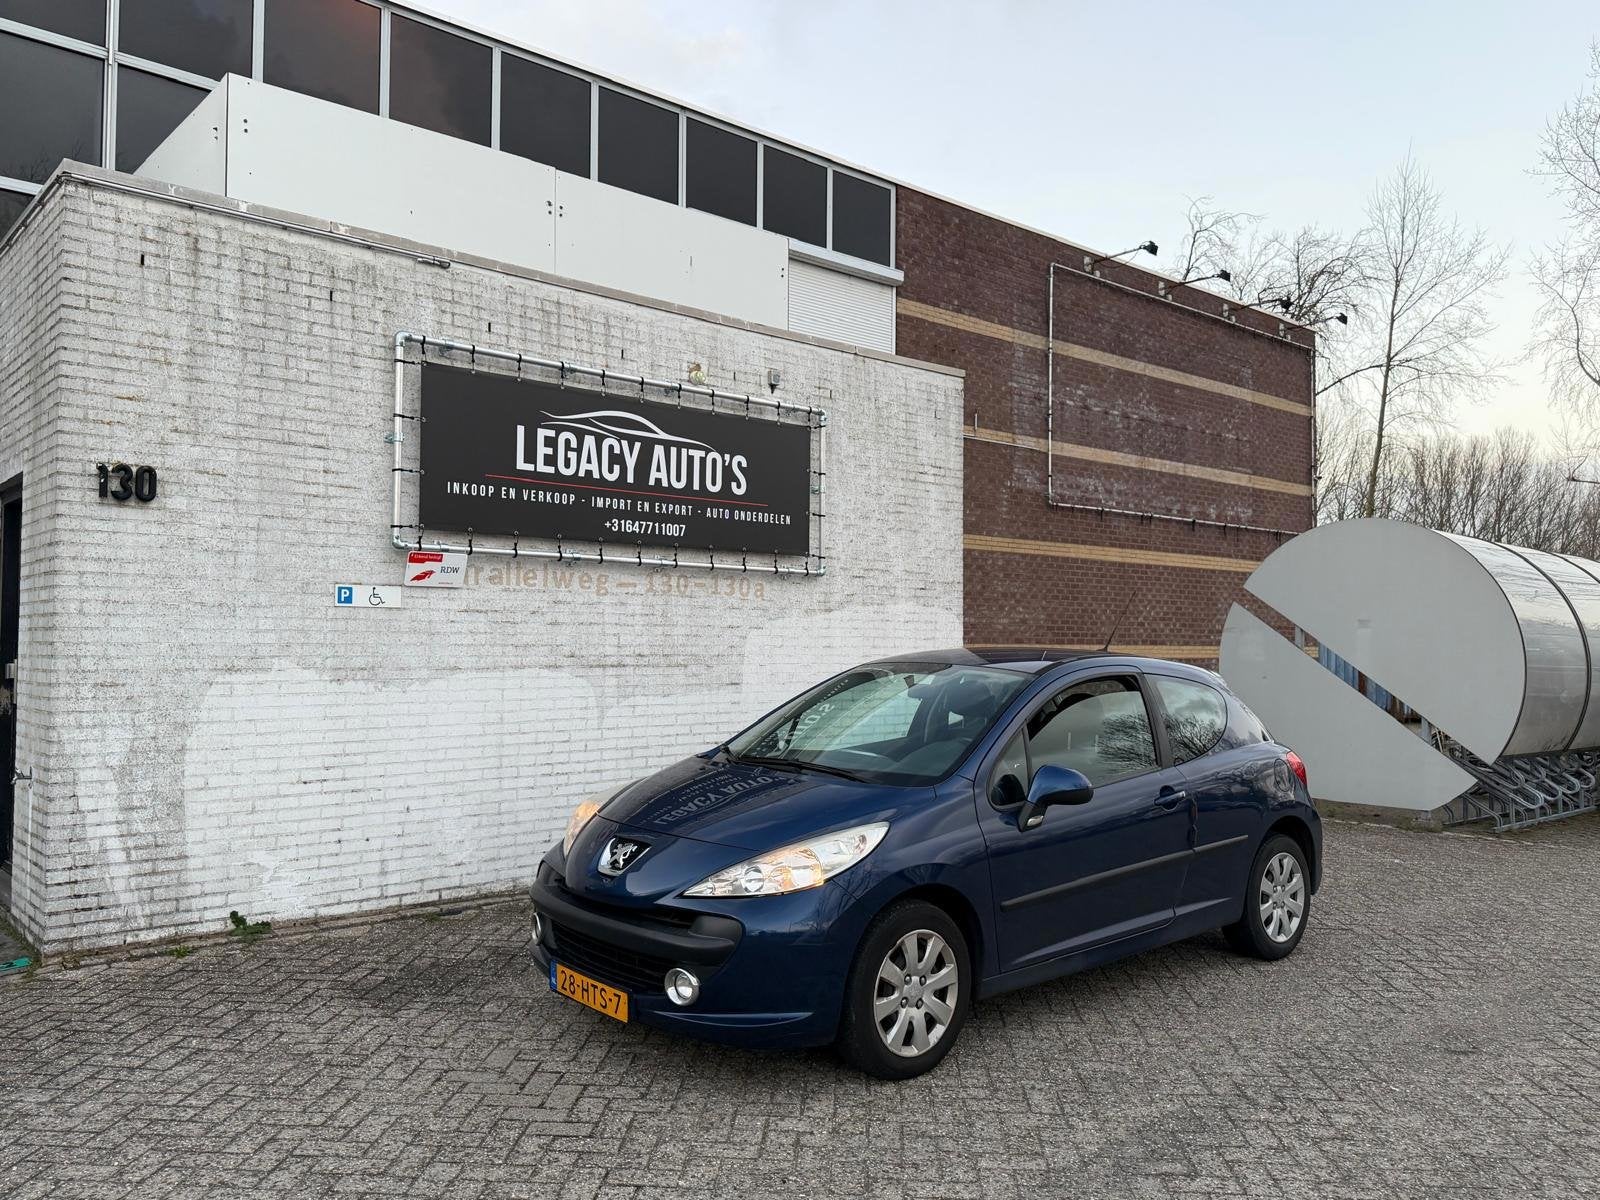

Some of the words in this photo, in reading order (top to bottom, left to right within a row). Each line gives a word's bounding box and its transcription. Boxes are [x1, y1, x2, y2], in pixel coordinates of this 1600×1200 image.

[515, 424, 642, 484] LEGACY
[648, 444, 748, 496] AUTO'S
[96, 462, 157, 502] 130
[447, 481, 495, 497] INKOOP
[501, 486, 516, 500] EN
[522, 489, 576, 505] VERKOOP
[591, 495, 632, 511] IMPORT
[637, 500, 650, 513] EN
[655, 502, 693, 516] EXPORT
[706, 507, 730, 520] AUTO
[734, 509, 791, 525] ONDERDELEN
[604, 518, 686, 537] +31647711007
[440, 566, 460, 574] RDW
[341, 589, 350, 602] P
[560, 970, 621, 1014] 28-HTS-7
